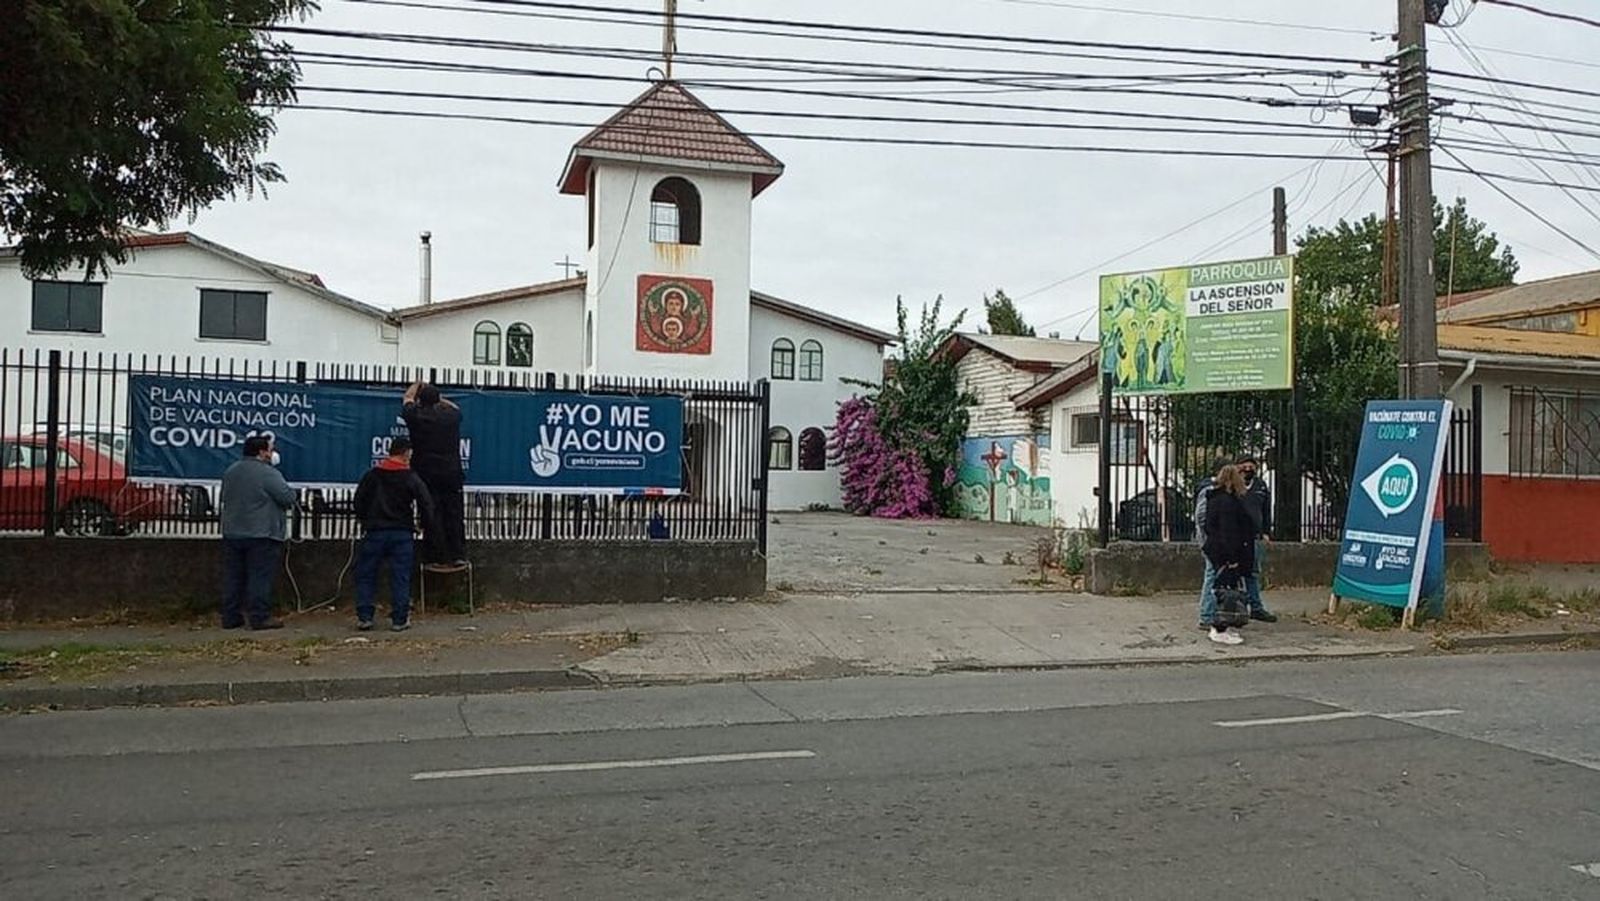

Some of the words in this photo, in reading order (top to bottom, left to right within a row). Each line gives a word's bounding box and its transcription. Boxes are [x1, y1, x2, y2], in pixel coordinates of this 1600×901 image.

[1191, 259, 1285, 282] PARROQUIA
[1190, 290, 1206, 302] LA
[1208, 282, 1285, 300] ASCENSIÓN
[1200, 302, 1224, 314] DEL
[1227, 297, 1273, 312] SEÑOR
[150, 386, 201, 403] PLAN
[208, 390, 313, 409] NACIONAL
[150, 406, 176, 422] DE
[182, 408, 316, 427] VACUNACIÓN
[546, 403, 601, 426] #YO
[610, 406, 650, 428] ME
[1381, 474, 1411, 497] AQUÍ
